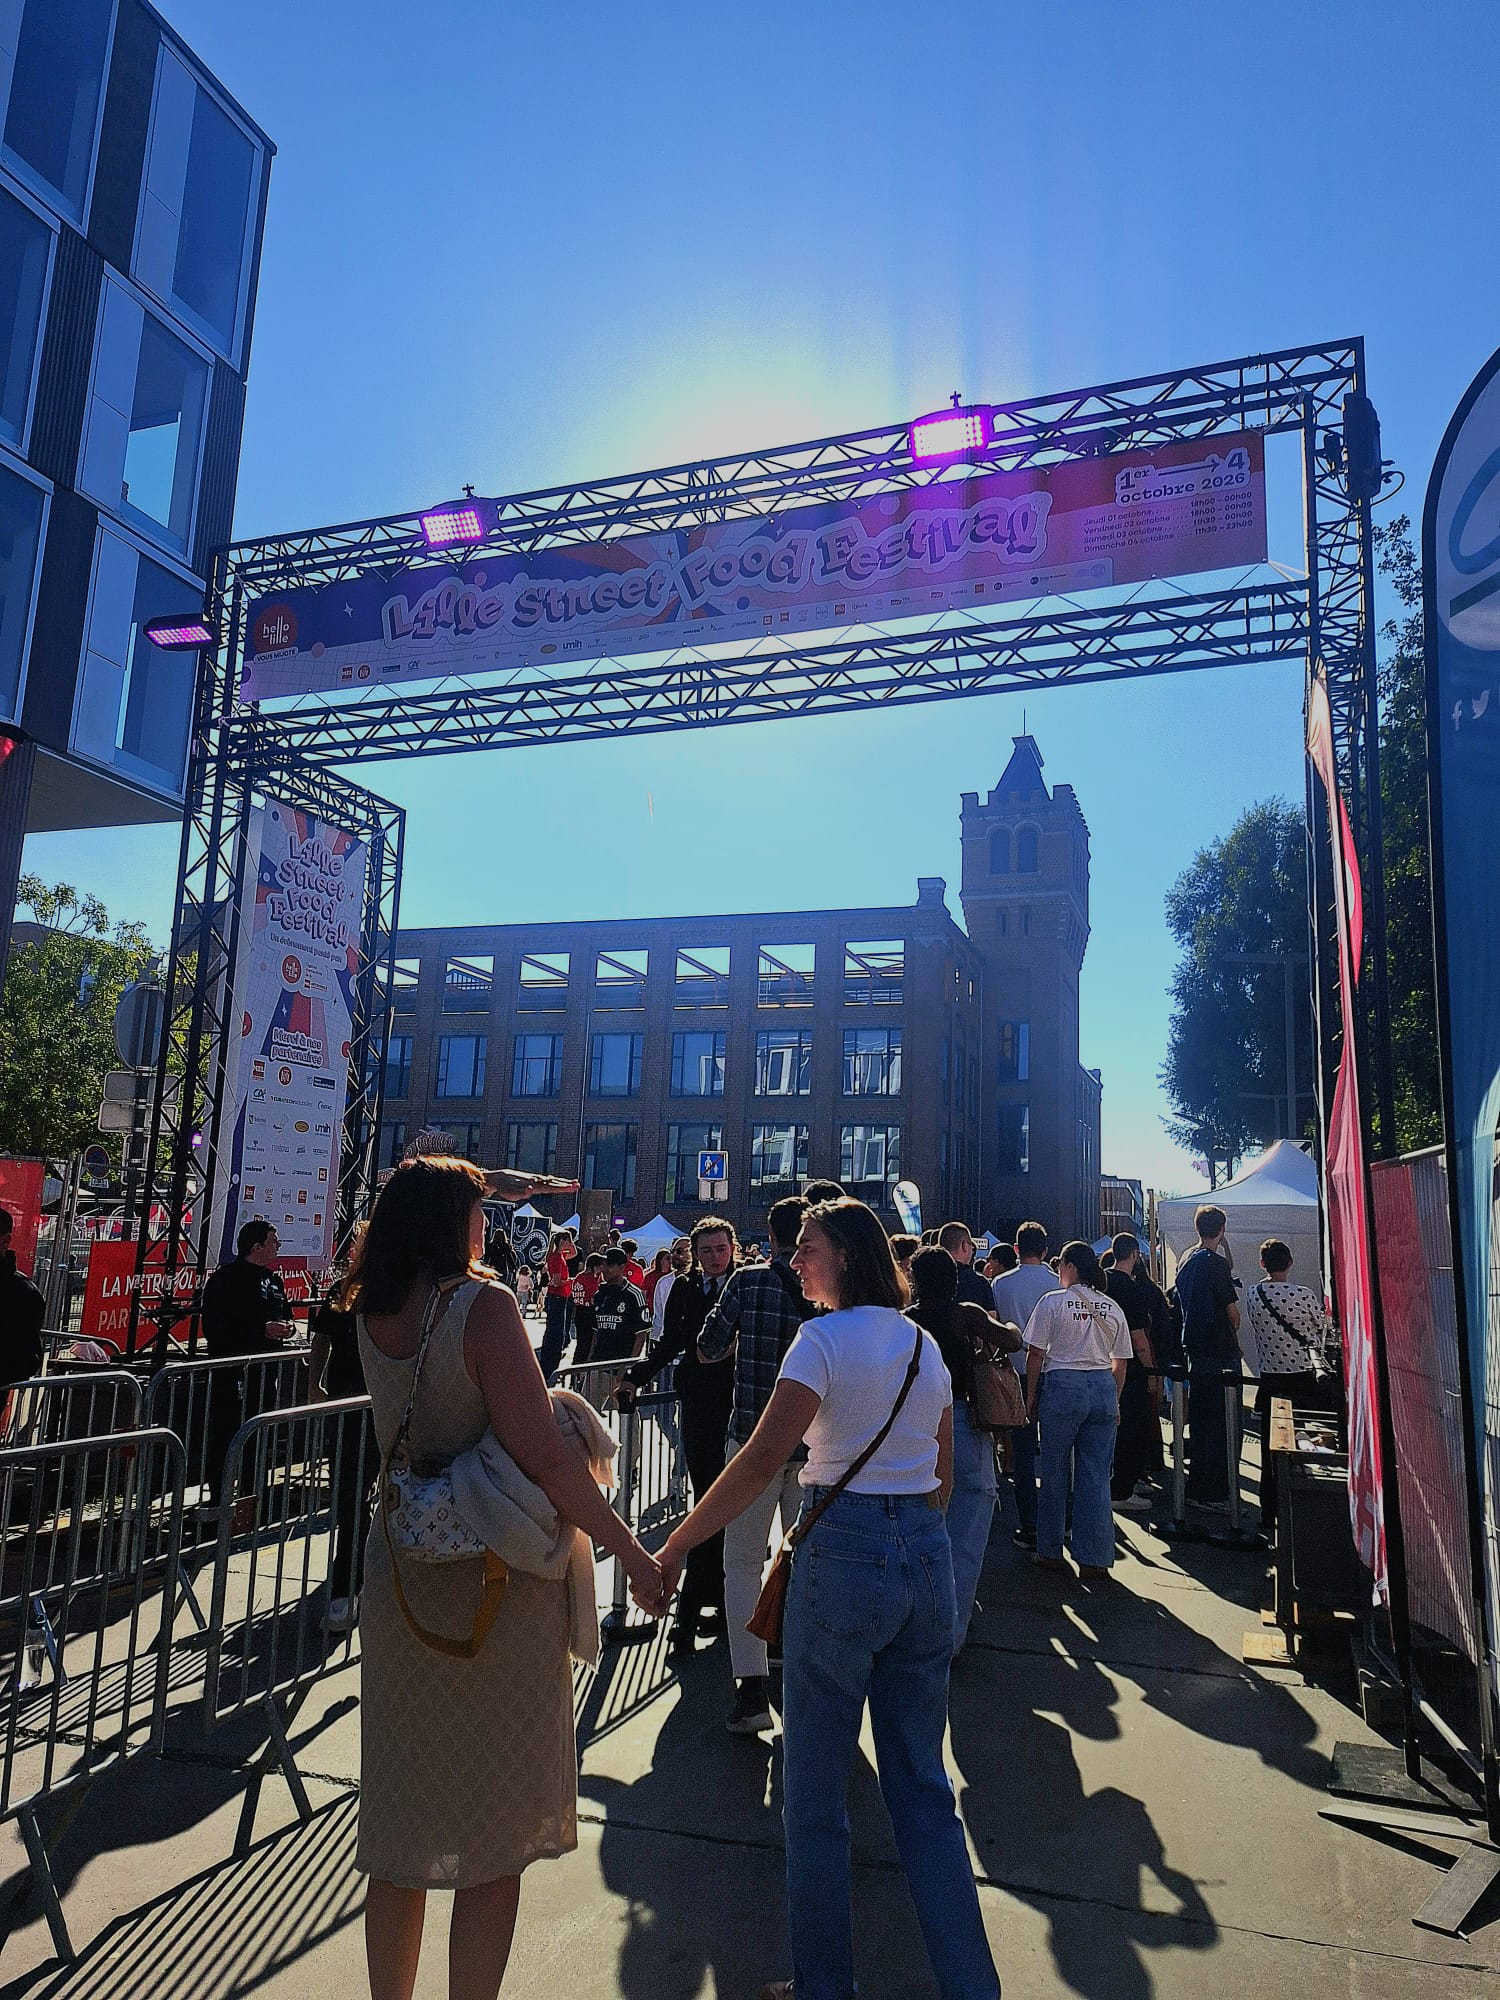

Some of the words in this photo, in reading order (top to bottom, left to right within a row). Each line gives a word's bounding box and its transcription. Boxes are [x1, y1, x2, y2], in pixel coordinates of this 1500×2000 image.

[1120, 469, 1150, 490] 1er
[1227, 451, 1246, 470] 4
[1120, 483, 1195, 503] octobre
[1201, 472, 1245, 490] 2026
[1107, 514, 1116, 522] 01
[1225, 491, 1252, 502] 00h00
[1225, 501, 1252, 511] 00h00
[1117, 530, 1127, 538] 03
[1225, 510, 1252, 520] 00h00
[1084, 540, 1126, 552] Dimanche
[390, 582, 505, 640] Lille
[511, 568, 668, 626] Street
[682, 537, 808, 602] Food
[815, 501, 1045, 582] Festival
[262, 616, 290, 635] hello
[257, 653, 273, 662] VOUS
[288, 834, 344, 878] Lille
[279, 858, 346, 902] Street
[286, 886, 337, 924] Food
[270, 896, 348, 949] Festival
[273, 1027, 299, 1044] Merci
[272, 1045, 322, 1065] partenaires
[102, 1276, 121, 1298] LA
[1067, 1301, 1112, 1311] PERECT
